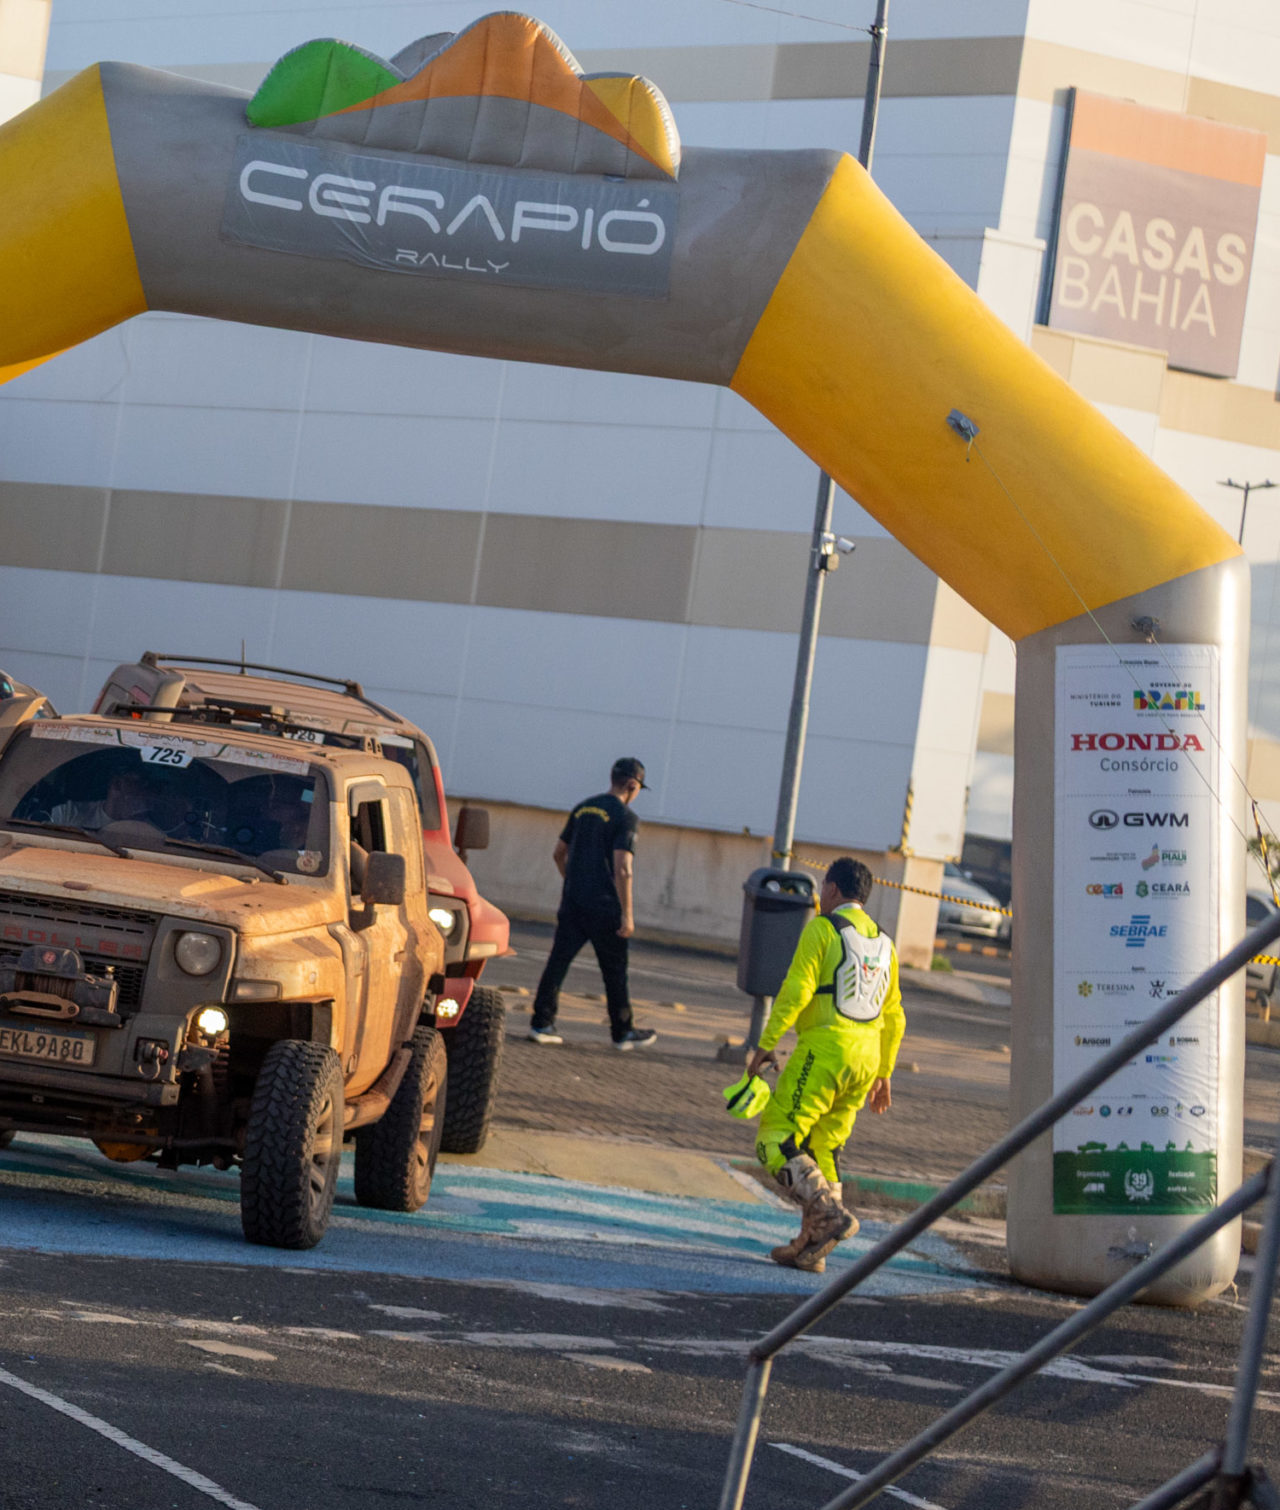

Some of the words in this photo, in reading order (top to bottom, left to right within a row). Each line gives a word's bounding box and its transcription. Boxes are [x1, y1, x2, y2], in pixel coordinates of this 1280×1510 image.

[239, 159, 666, 256] CERAPIÓ
[1066, 202, 1247, 286] CASAS
[395, 248, 510, 273] RALLY
[1058, 256, 1217, 338] BAHIA
[1071, 732, 1205, 751] HONDA
[149, 746, 186, 765] 725
[1100, 757, 1179, 772] Consórcio
[1123, 812, 1189, 828] GWM
[1152, 880, 1190, 892] CEARÁ
[1109, 925, 1168, 937] SEBRAE
[1096, 983, 1135, 992] TERESINA
[0, 1029, 84, 1060] EKL9A80
